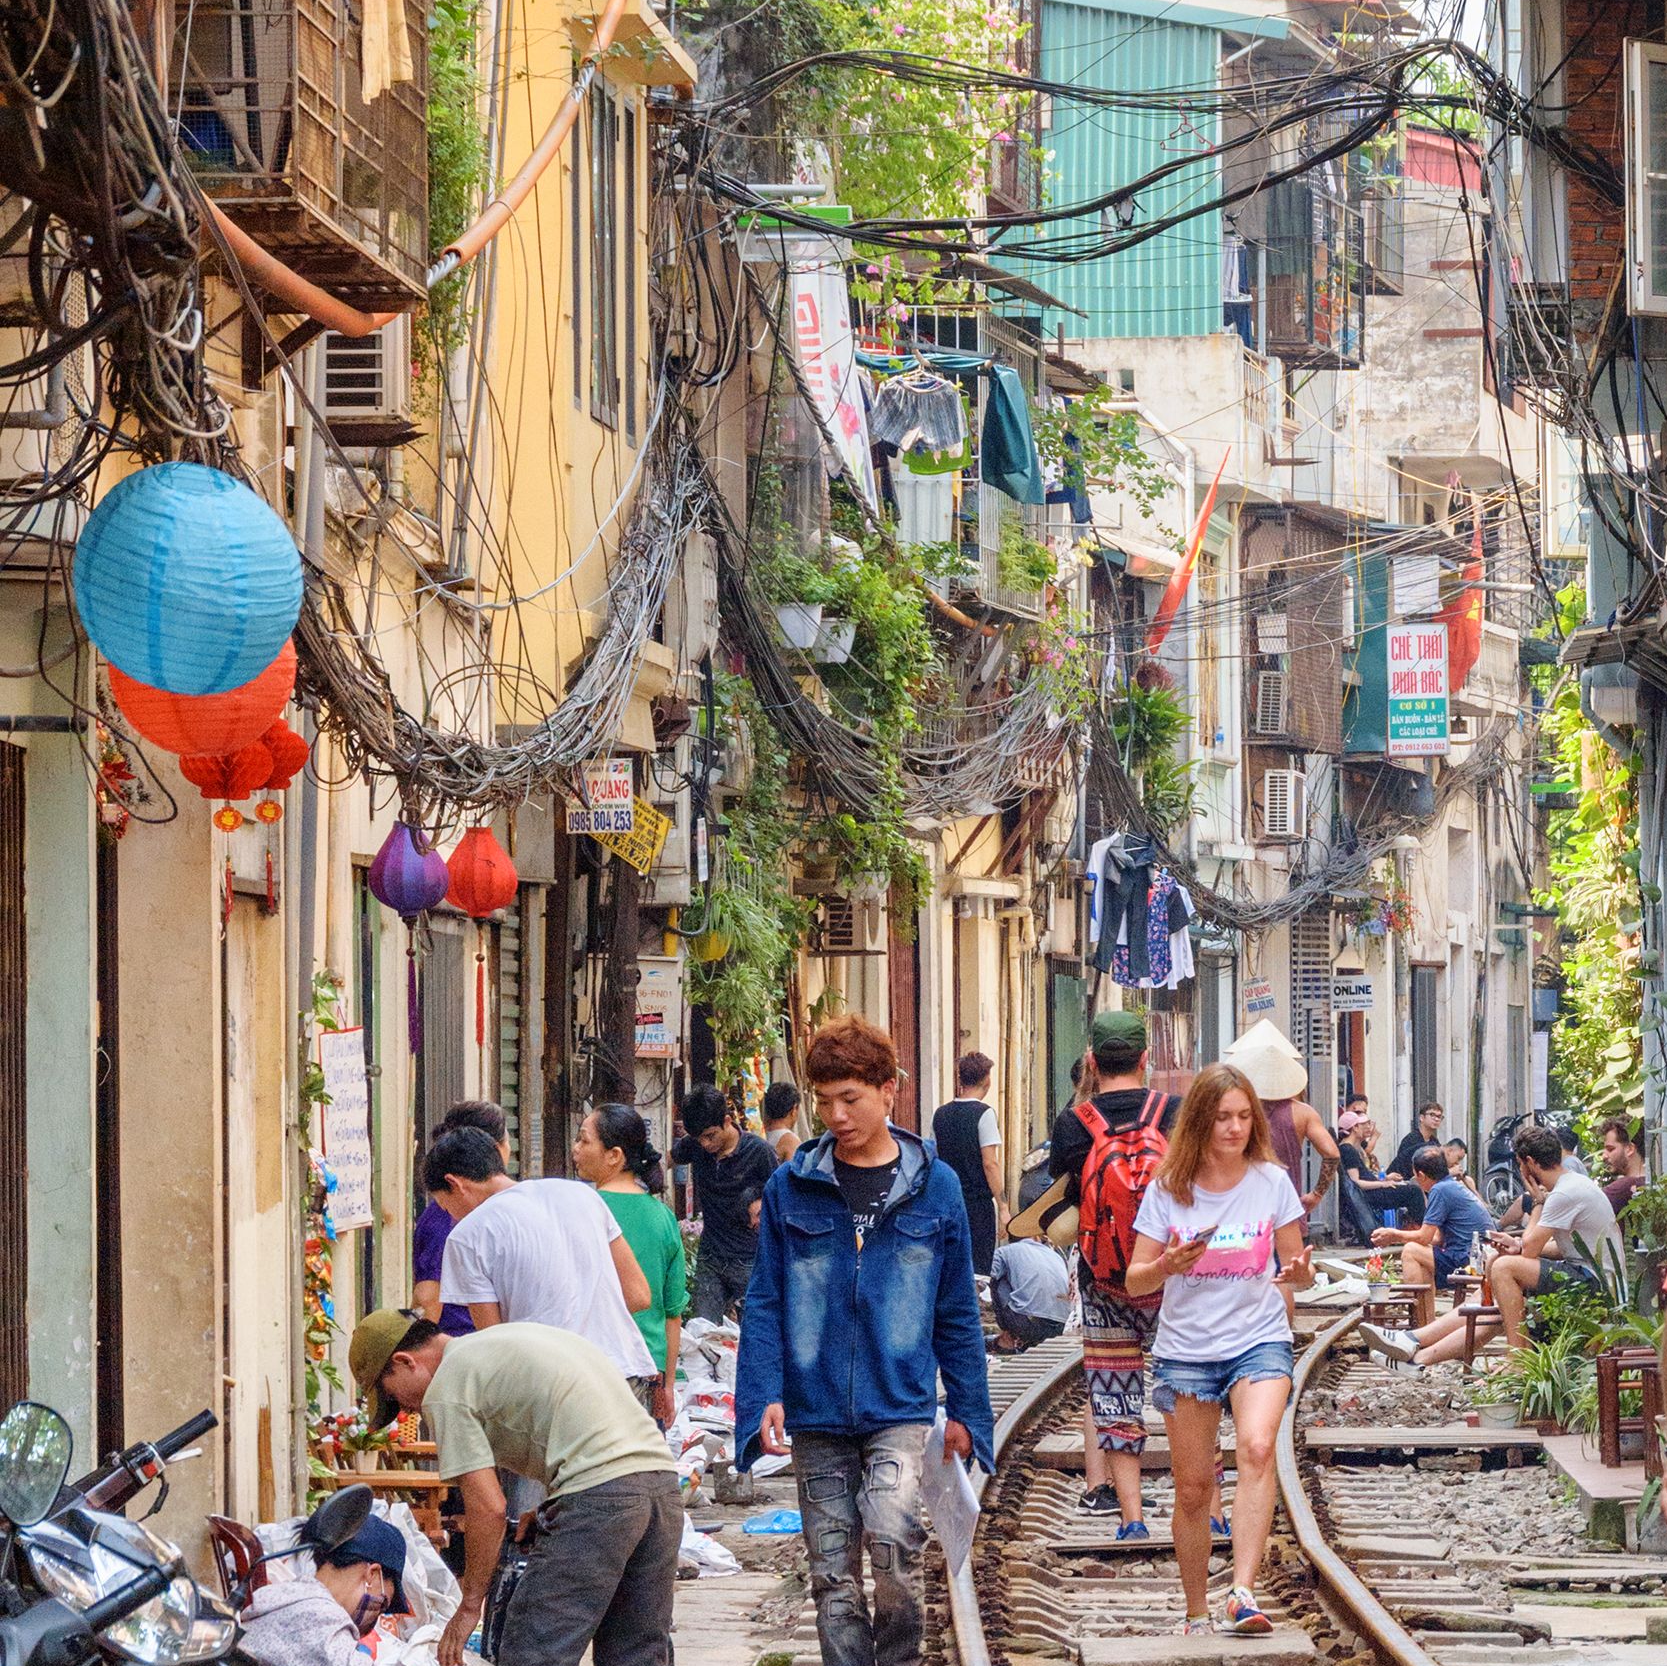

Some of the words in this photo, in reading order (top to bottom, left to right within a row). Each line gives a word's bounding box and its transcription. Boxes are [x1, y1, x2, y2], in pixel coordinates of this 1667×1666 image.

[1391, 631, 1413, 661] CHÈ
[1416, 630, 1443, 660] THÁI
[1392, 668, 1418, 694] PHÍA
[1421, 664, 1443, 694] BẮC
[568, 811, 591, 831] 0985
[593, 811, 612, 831] 804
[613, 810, 632, 831] 253
[1333, 984, 1372, 996] ONLINE
